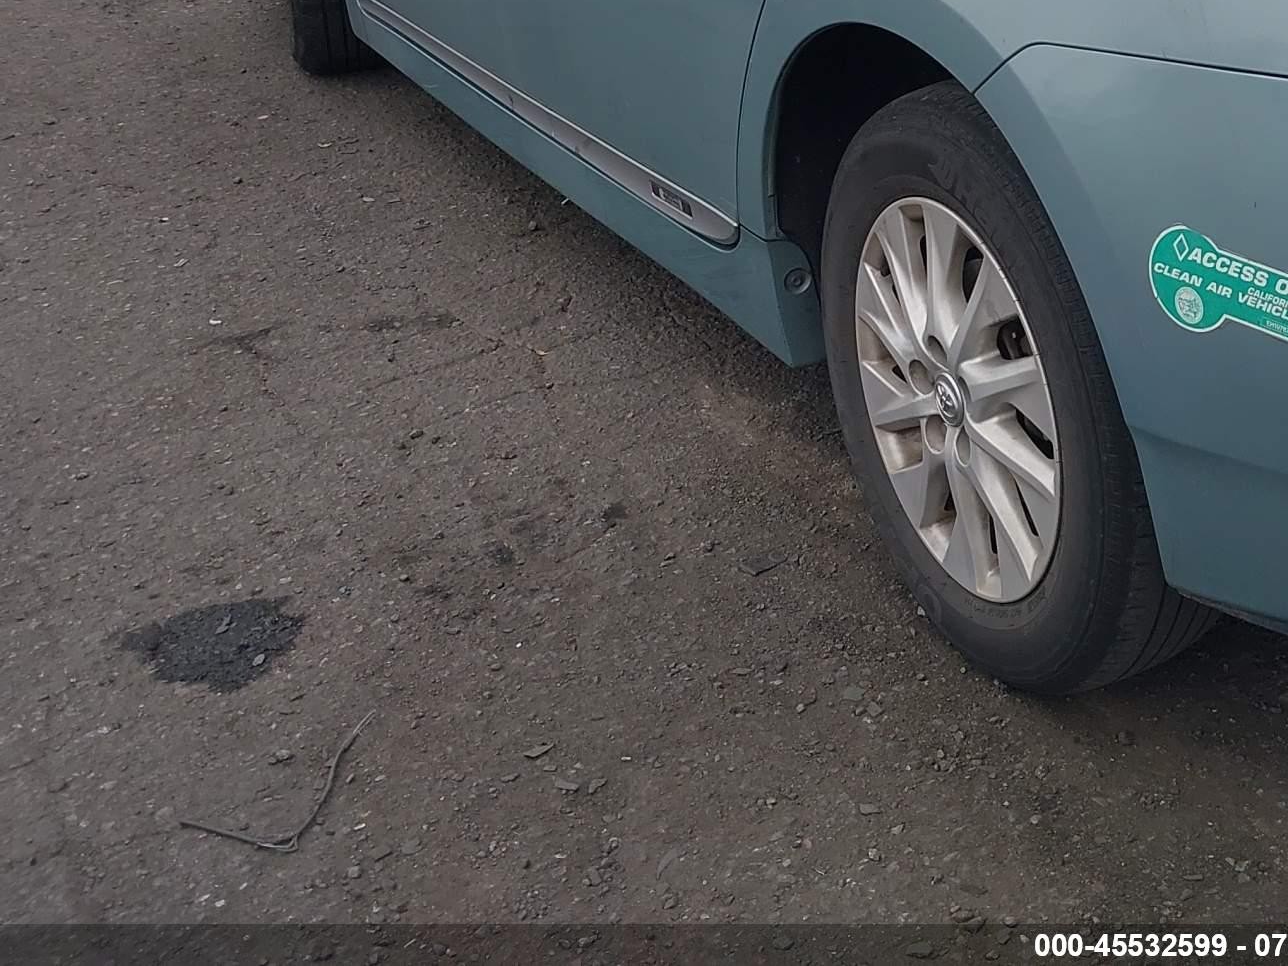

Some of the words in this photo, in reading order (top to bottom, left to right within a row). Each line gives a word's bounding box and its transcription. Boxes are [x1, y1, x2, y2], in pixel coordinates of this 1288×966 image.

[1153, 262, 1203, 287] CLEAN
[1206, 281, 1233, 299] AIR
[1187, 247, 1269, 287] ACCESS
